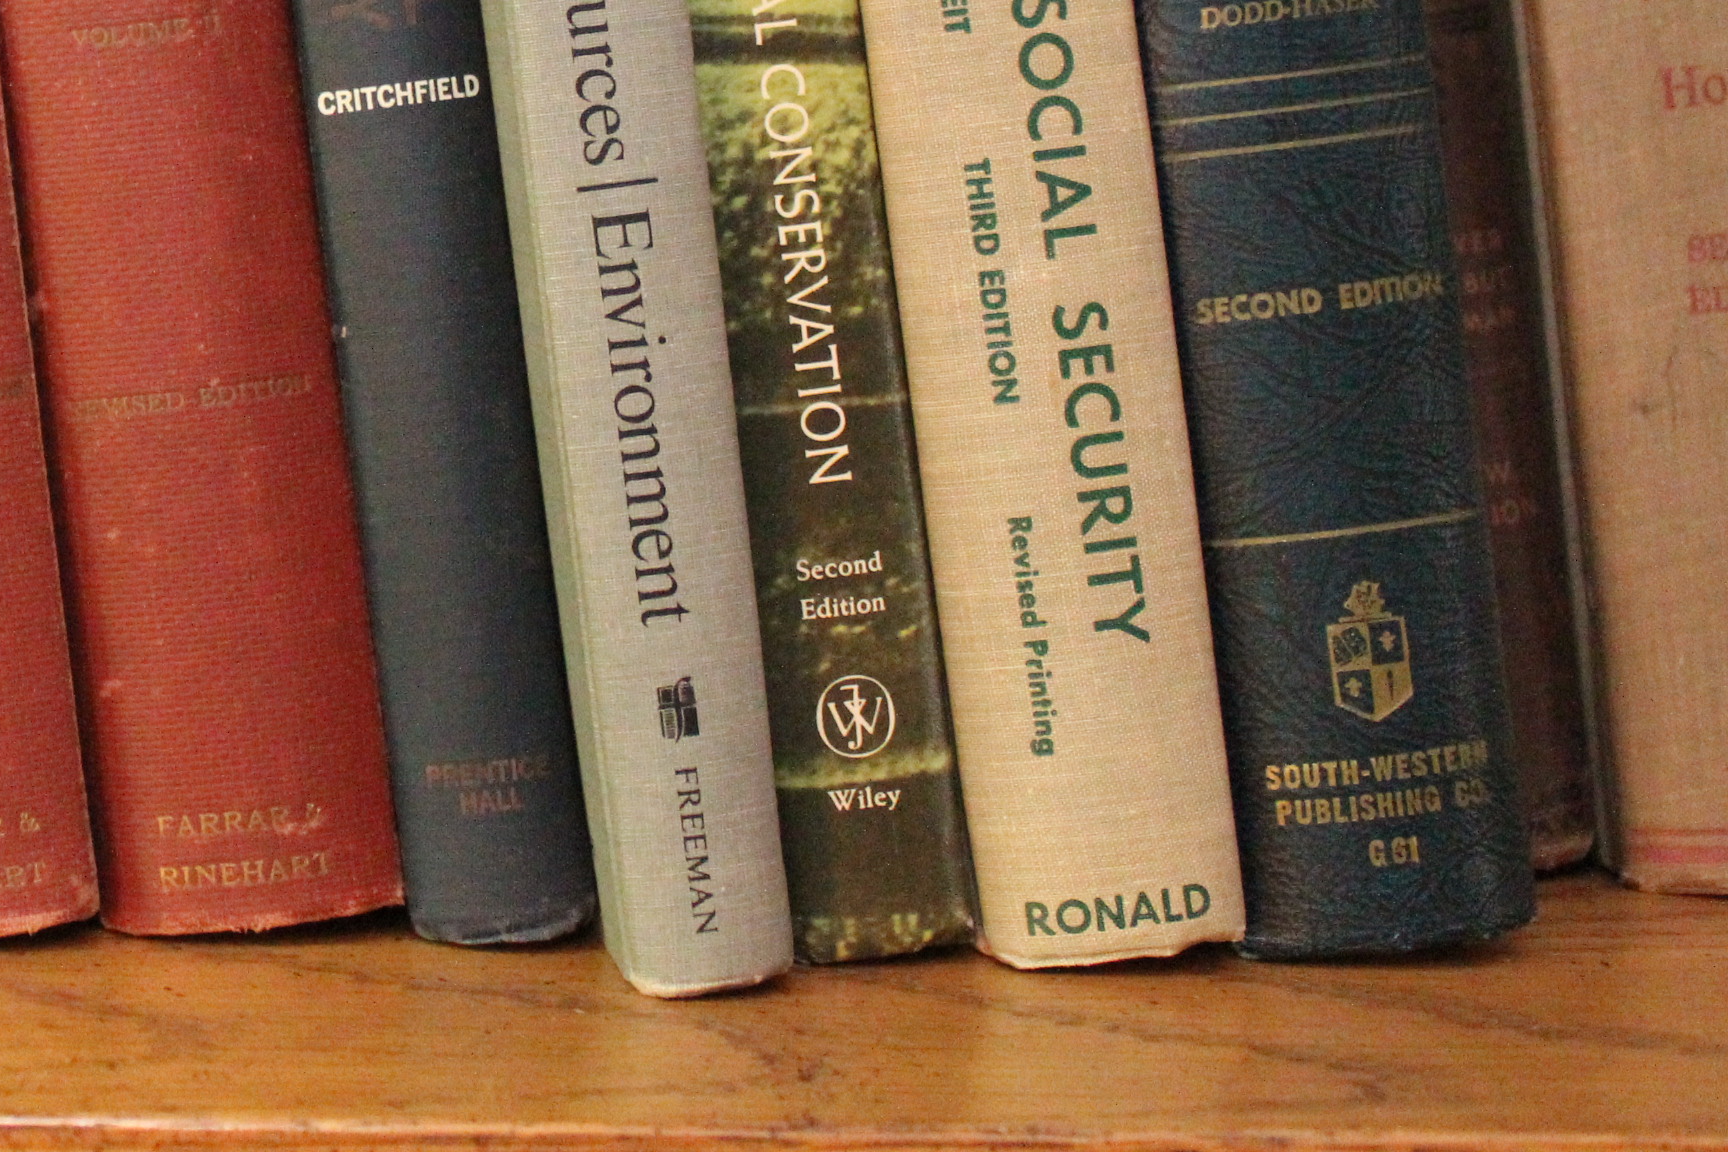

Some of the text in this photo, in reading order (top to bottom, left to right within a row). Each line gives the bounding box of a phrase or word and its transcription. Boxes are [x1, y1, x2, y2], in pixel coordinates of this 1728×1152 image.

[317, 74, 480, 116] CRITCHFIELD
[760, 64, 853, 485] CONSERVATION
[963, 157, 1020, 405] THIRD EDITION
[1194, 288, 1324, 326] SECOND
[1338, 270, 1446, 310] EDITION
[591, 208, 691, 627] Environment
[1052, 301, 1151, 644] SECURITY
[796, 551, 884, 582] Second
[800, 595, 886, 621] Edition
[1007, 515, 1060, 757] Revised Printing
[1265, 740, 1489, 791] SOUTH-WESTERN
[827, 788, 902, 813] Wiley
[1275, 785, 1442, 827] PUBLISHING
[158, 851, 330, 892] RINEHART
[674, 765, 718, 935] FREEMAN
[1024, 883, 1211, 937] RONALD
